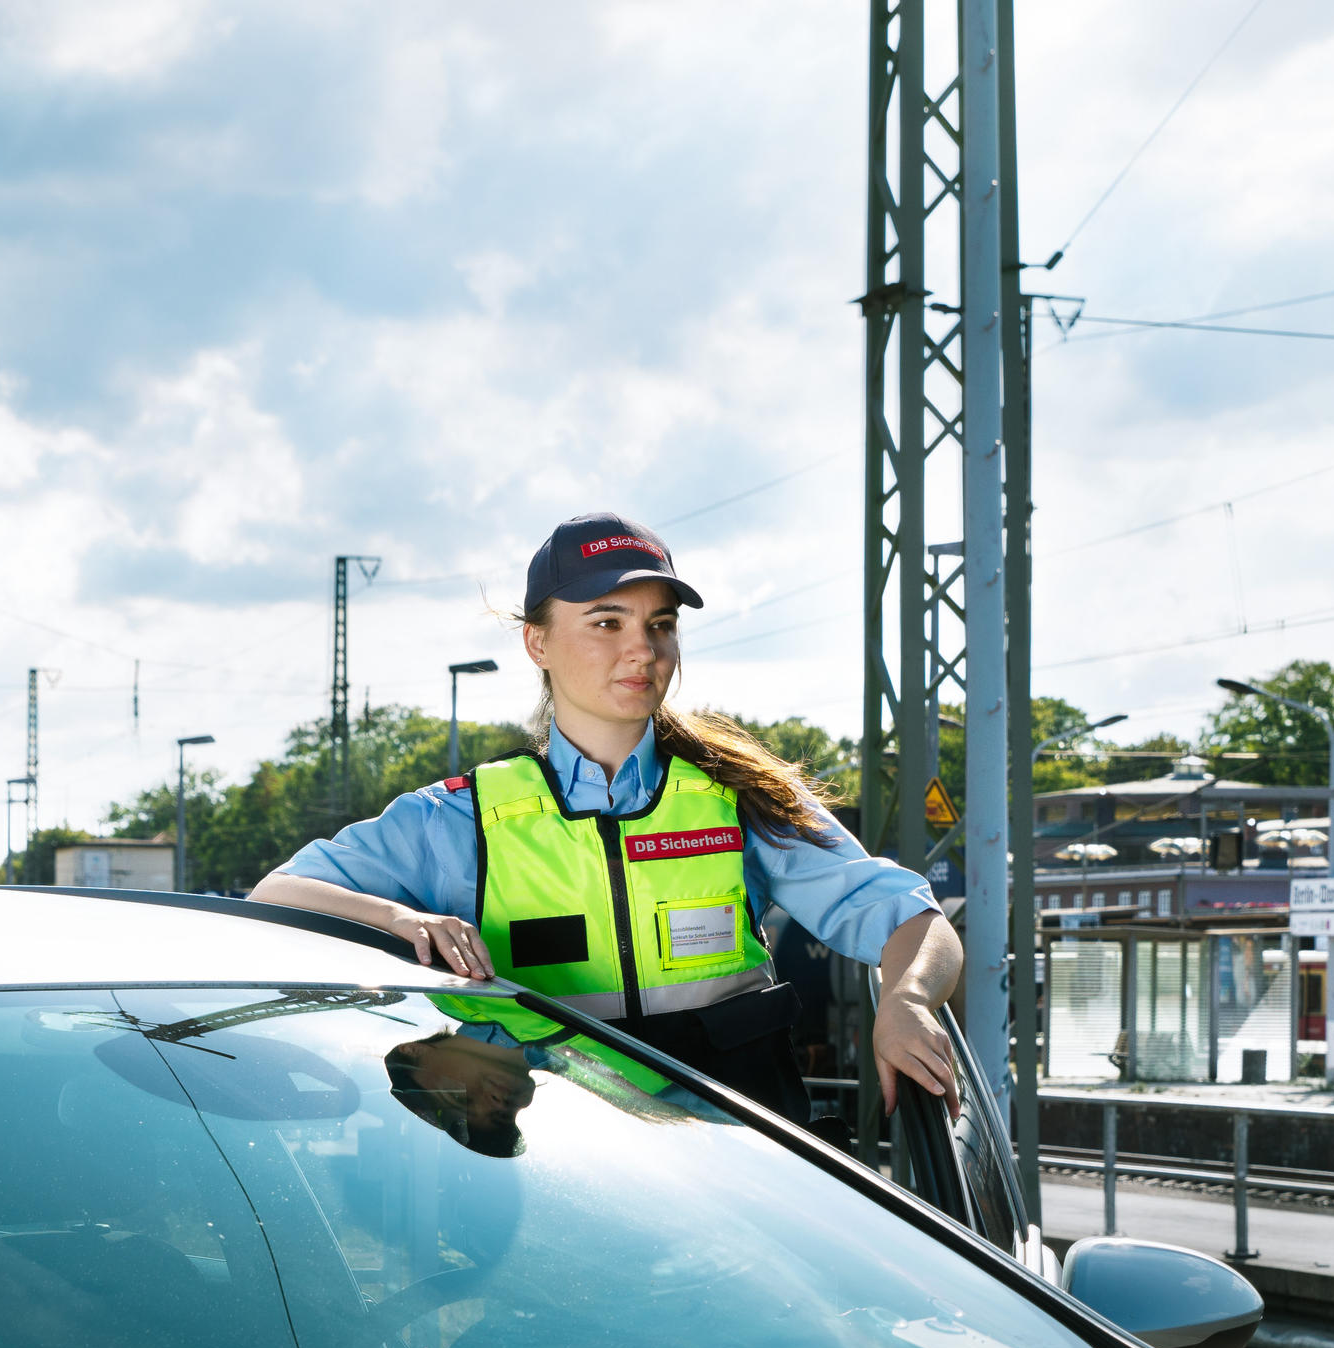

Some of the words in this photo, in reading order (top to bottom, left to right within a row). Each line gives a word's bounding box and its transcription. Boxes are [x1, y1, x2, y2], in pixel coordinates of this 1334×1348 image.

[589, 540, 607, 552] DB
[634, 840, 656, 853] DB
[660, 832, 735, 850] Sicherheit
